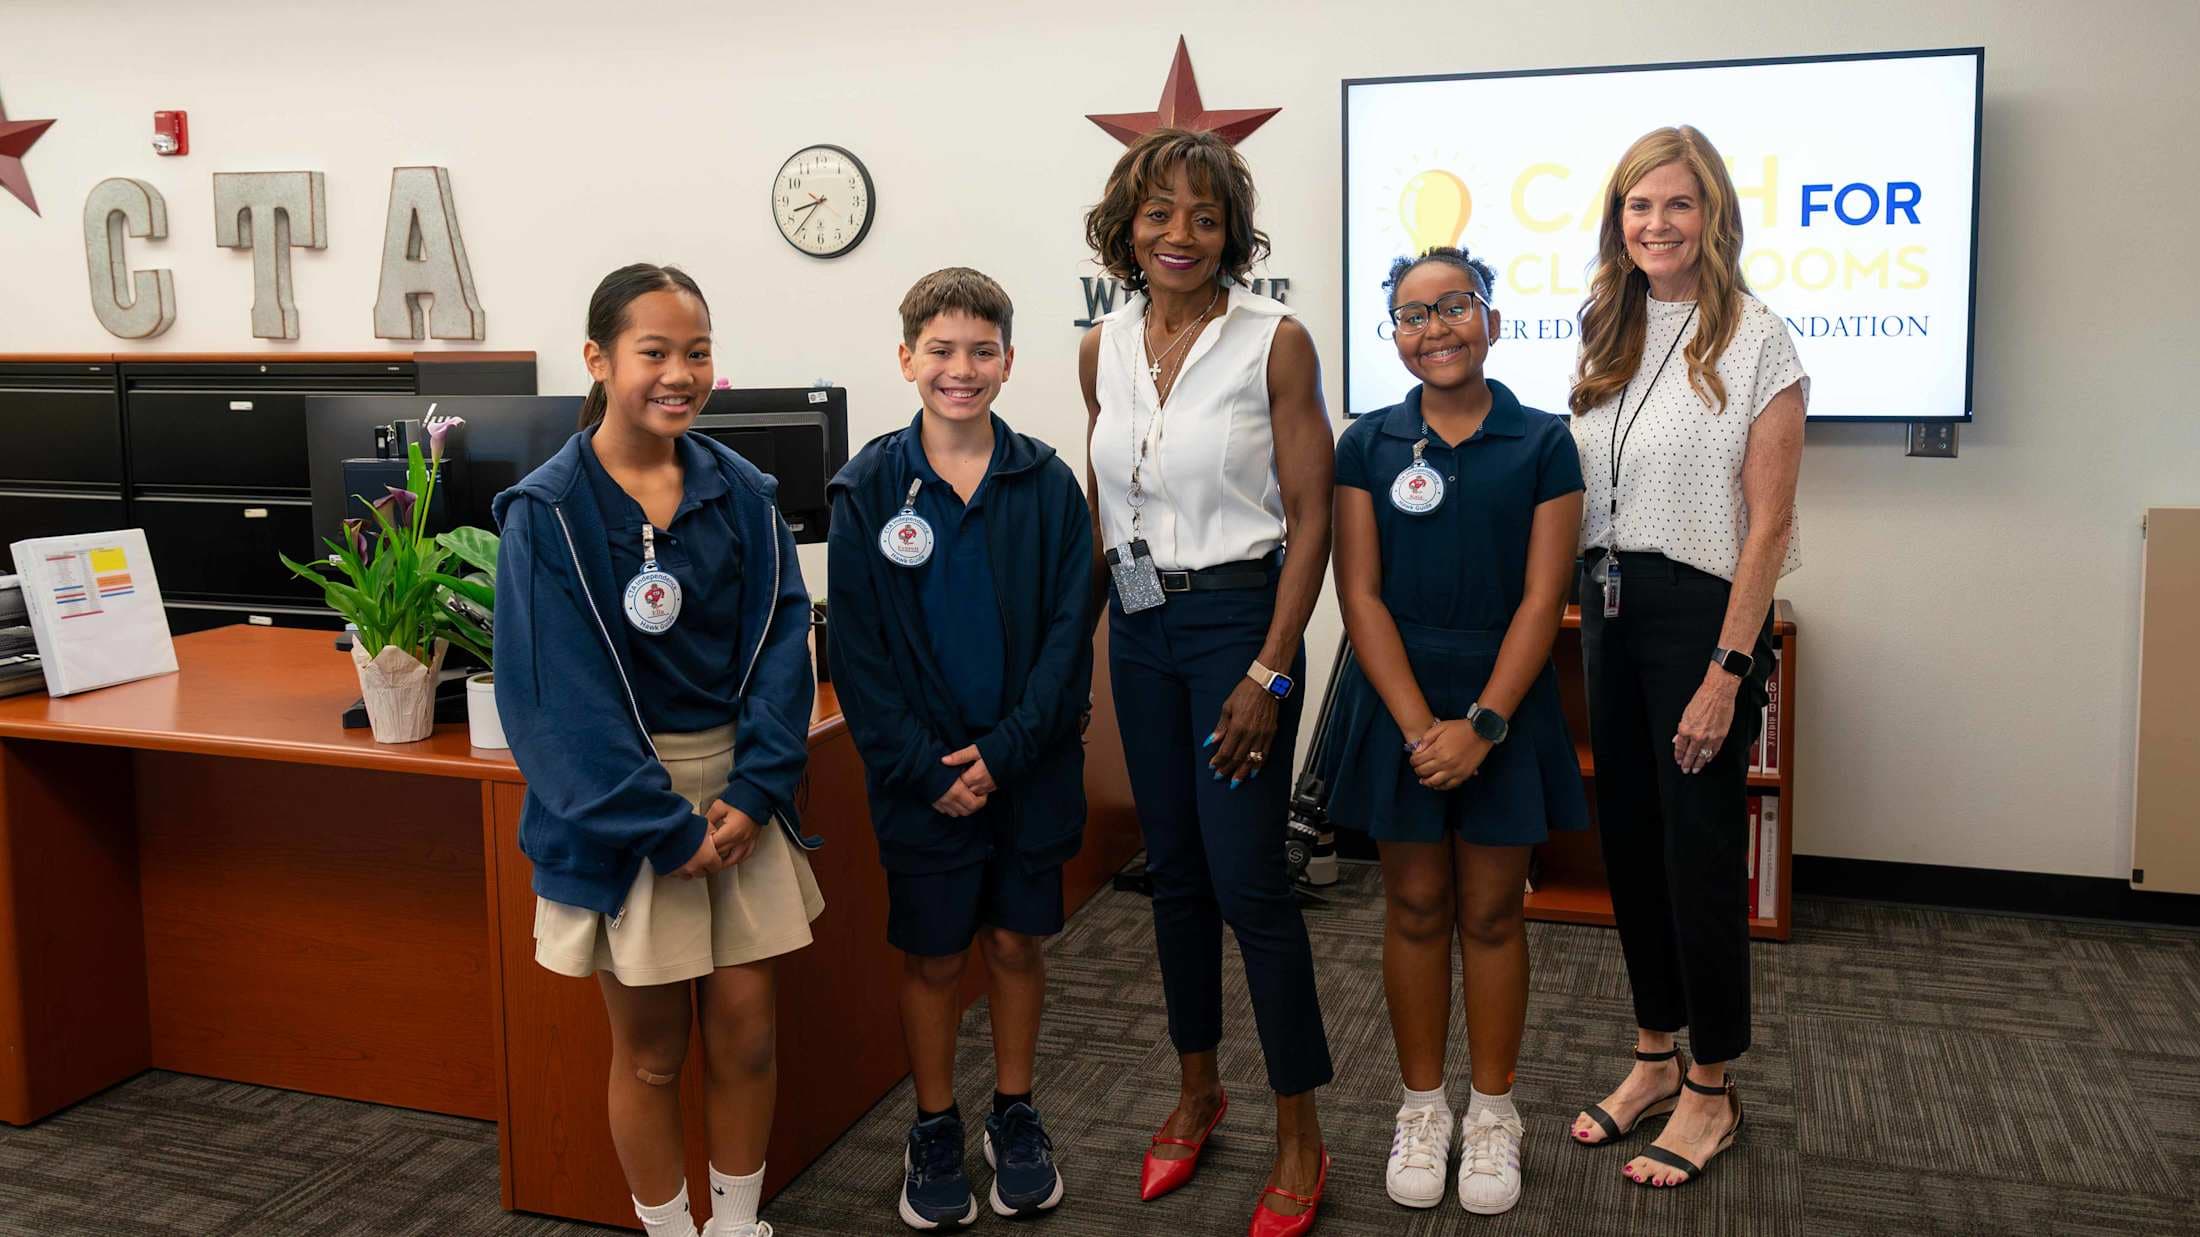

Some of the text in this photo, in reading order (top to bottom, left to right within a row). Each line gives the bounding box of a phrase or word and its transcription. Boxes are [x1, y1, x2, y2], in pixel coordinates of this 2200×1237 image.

[788, 178, 801, 190] 10
[1510, 154, 1922, 234] CH FOR
[84, 166, 486, 340] CTA
[1507, 245, 1930, 296] CLOOMS
